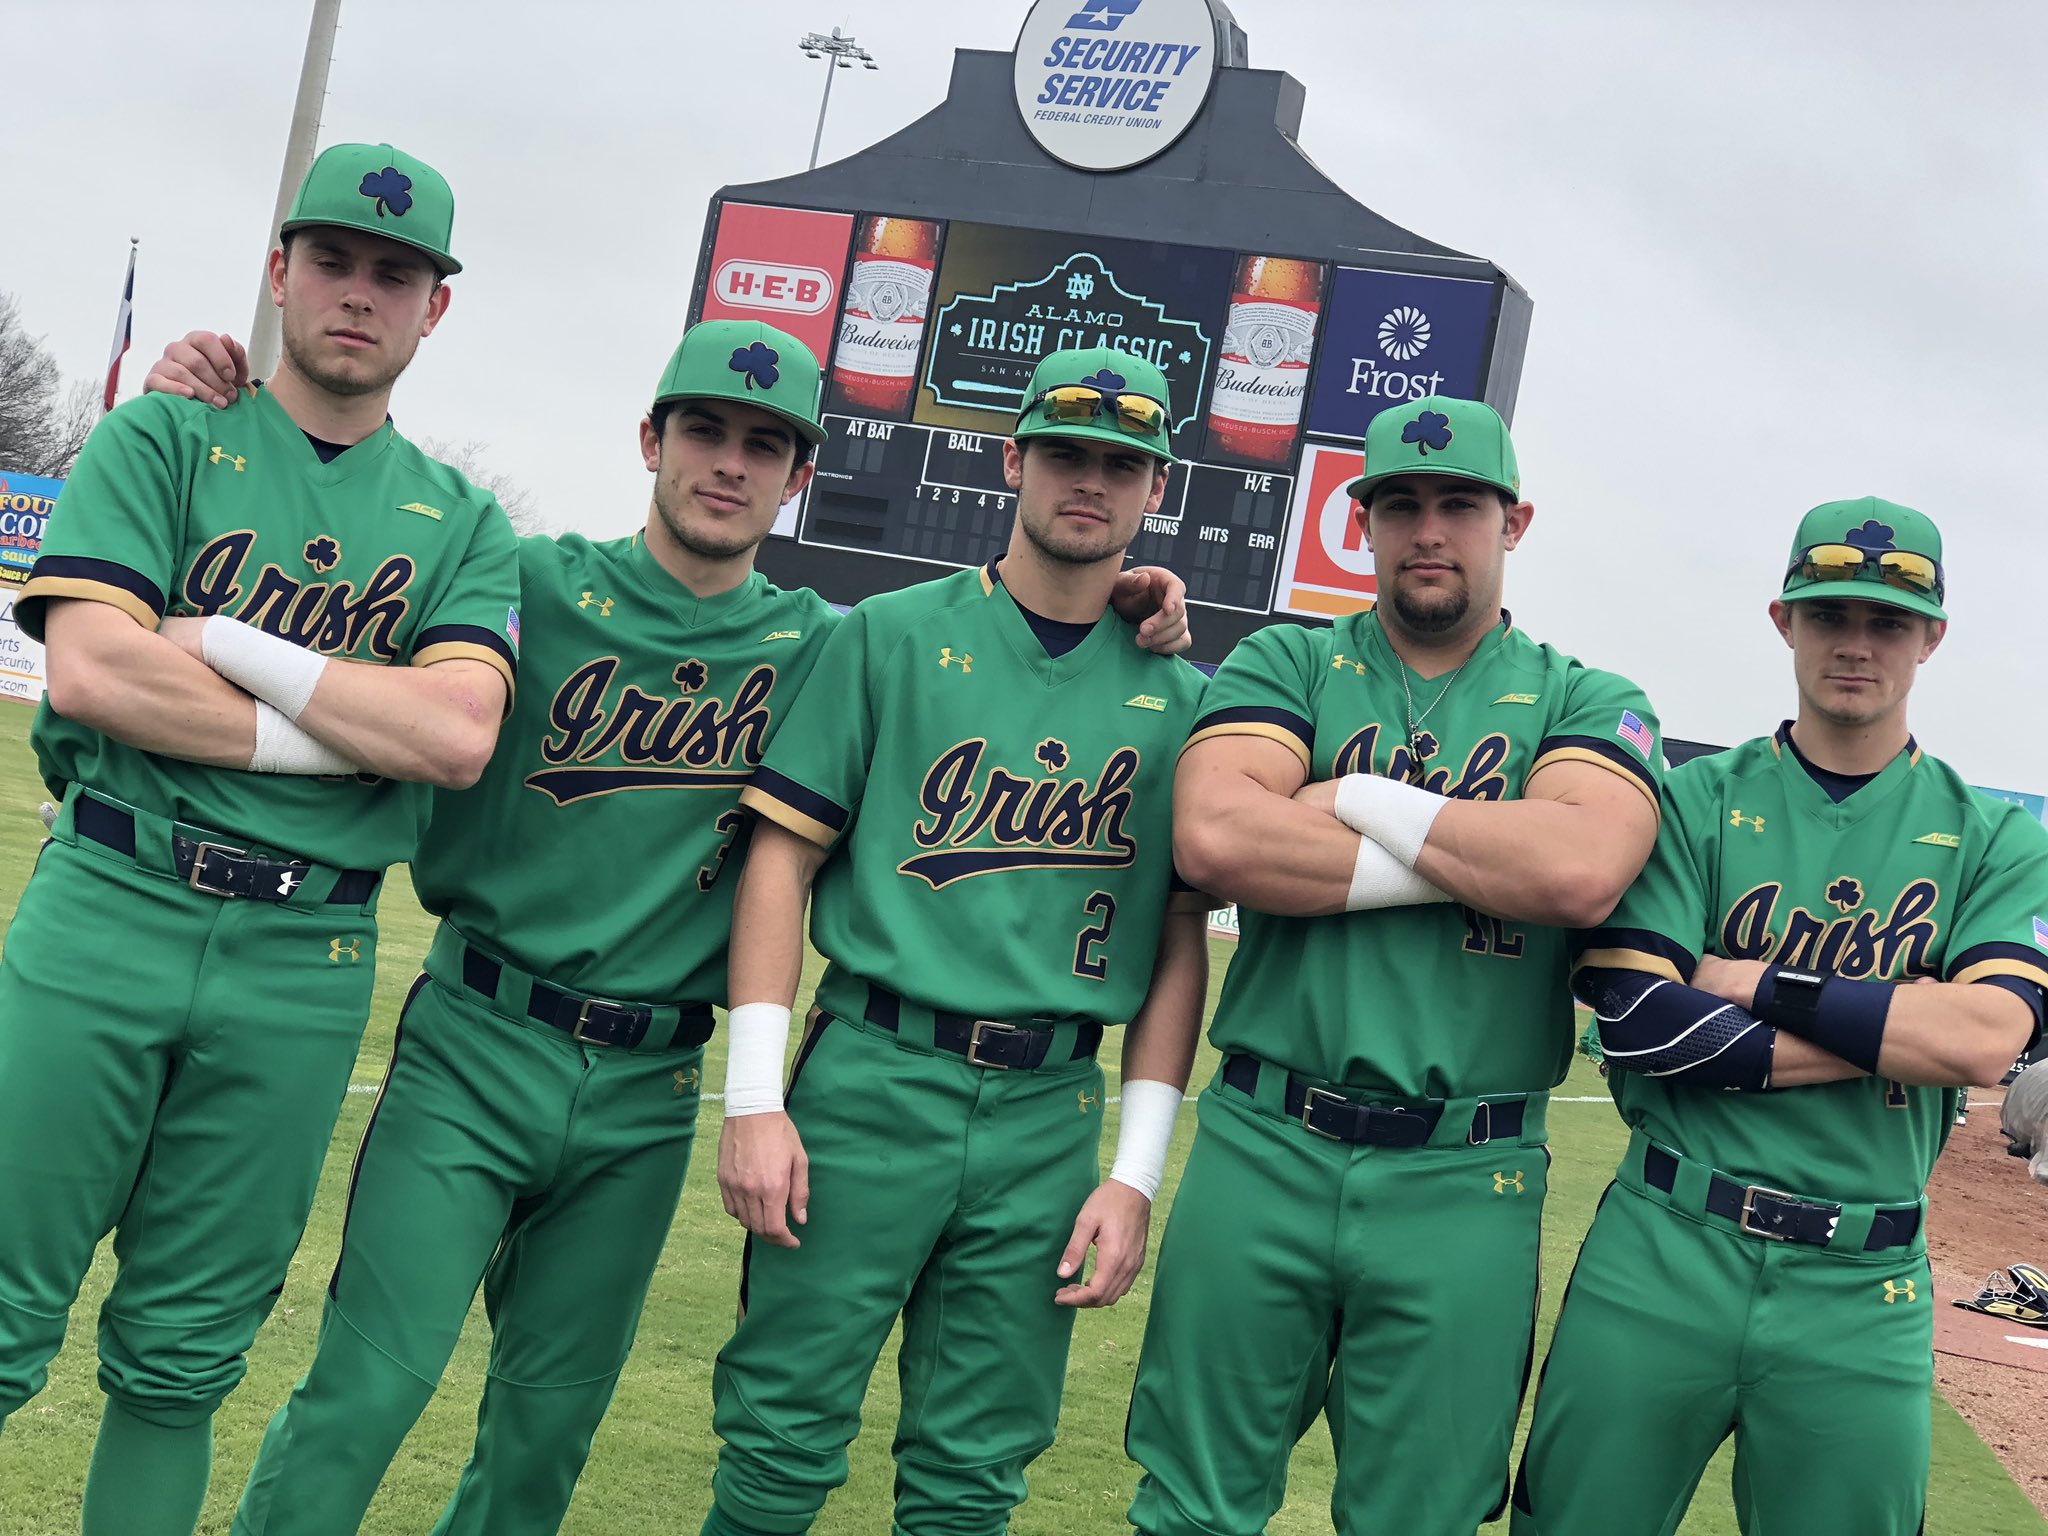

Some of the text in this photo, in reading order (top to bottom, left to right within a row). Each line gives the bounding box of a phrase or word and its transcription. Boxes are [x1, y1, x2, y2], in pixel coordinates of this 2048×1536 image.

[1043, 36, 1201, 76] SECURITY
[1037, 73, 1171, 112] SERVICE
[1034, 110, 1162, 129] FEDERAL CREDIT UNION
[1025, 304, 1123, 327] ALAMO
[839, 321, 920, 351] Budweiser
[967, 317, 1173, 371] IRISH CLASSIC
[981, 364, 1006, 375] SAN
[1215, 366, 1306, 397] Budweiser
[1346, 357, 1445, 400] Frost
[846, 420, 895, 441] AT BAT
[947, 433, 983, 453] BALL
[816, 470, 853, 480] DAKTRONICS
[1244, 473, 1273, 493] H/E
[915, 485, 1006, 510] 1 2 3 4 5
[403, 502, 443, 518] ACC
[1143, 517, 1275, 550] RUNS HITS ERR
[179, 529, 416, 662] Irish
[0, 638, 20, 653] rts
[762, 630, 801, 641] ACC
[0, 679, 28, 693] .com
[1128, 694, 1166, 709] ACC
[1496, 693, 1539, 705] ACC
[541, 655, 777, 769] Irish
[913, 737, 1140, 850] Irish
[696, 809, 746, 892] 3
[1922, 832, 1960, 846] ACC
[1071, 890, 1117, 981] 2
[1721, 878, 1940, 981] Irish
